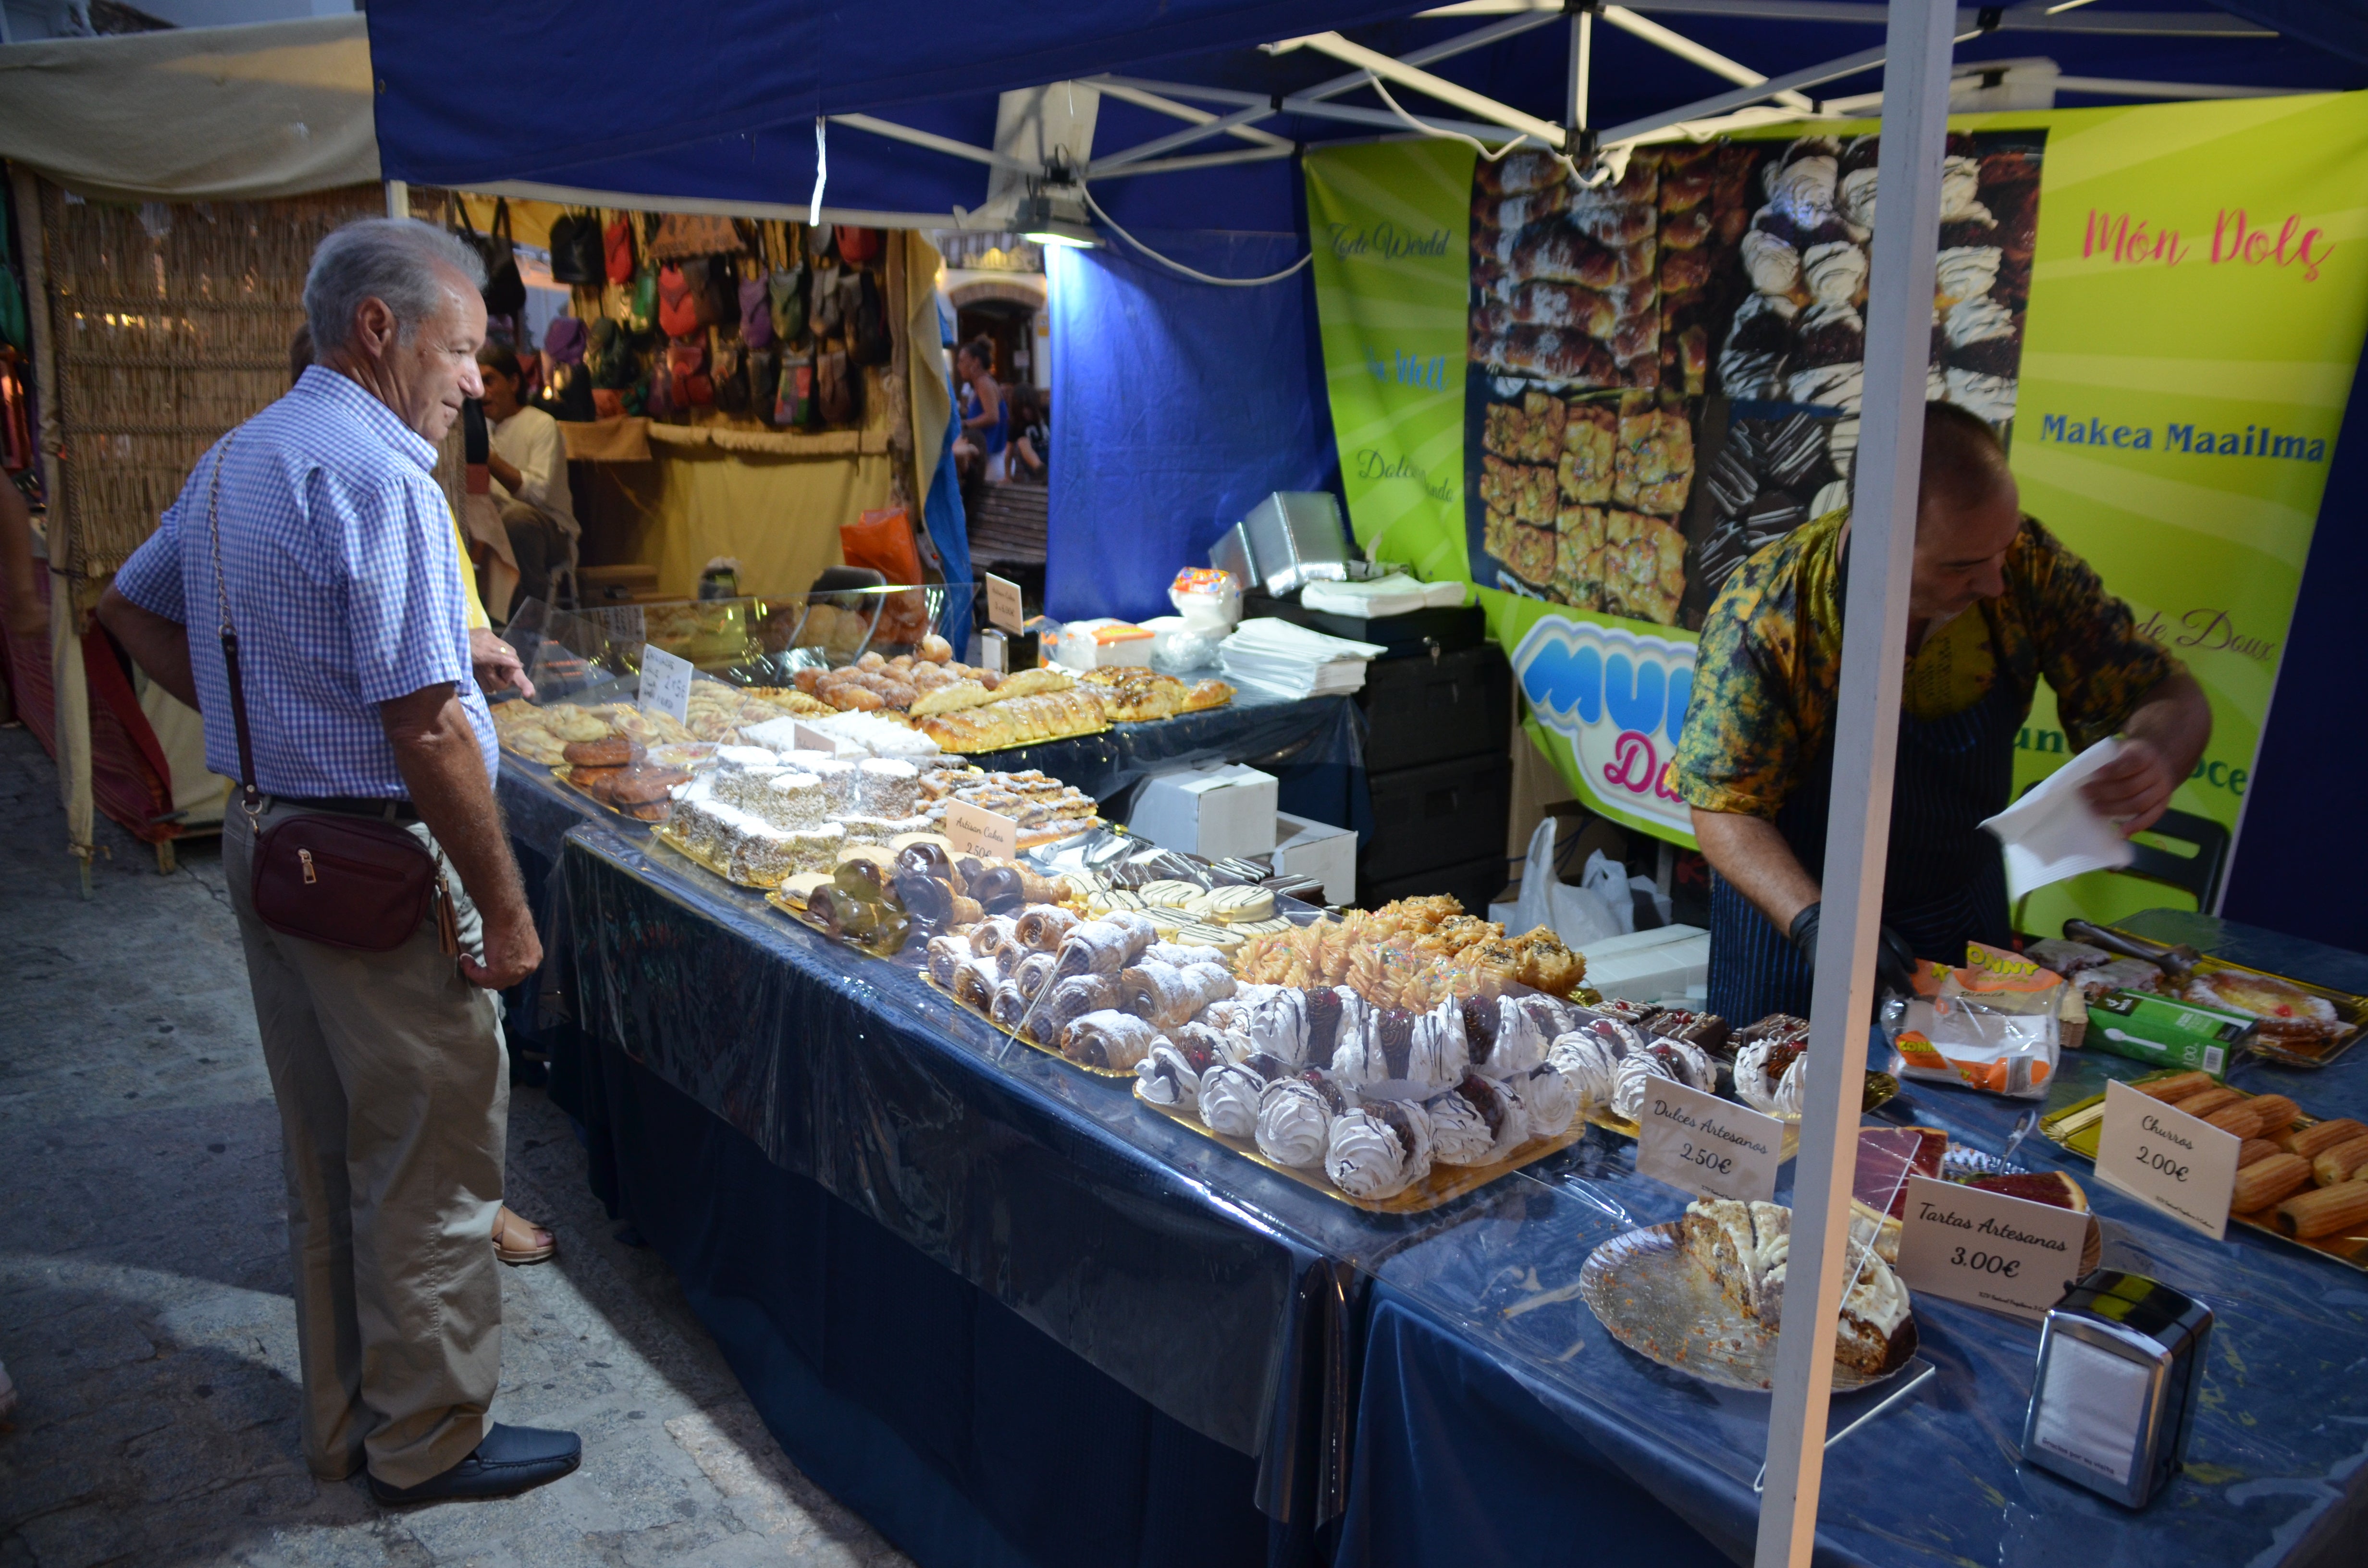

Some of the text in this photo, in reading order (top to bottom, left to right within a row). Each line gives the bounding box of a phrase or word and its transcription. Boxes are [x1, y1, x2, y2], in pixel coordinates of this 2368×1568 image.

[2083, 208, 2336, 282] Món Dolç
[2040, 413, 2327, 463] Makea Maailma
[2177, 607, 2276, 662] Doux
[956, 817, 1004, 843] Artisan Cakes
[1653, 1099, 1768, 1154] Dulces Artesanos
[2142, 1115, 2194, 1150] Churros
[1680, 1143, 1733, 1175] 2.50€
[2136, 1146, 2190, 1182] 2.00€
[1919, 1202, 2068, 1252] Tartas Artesanas
[1951, 1247, 2020, 1278] 3.00€
